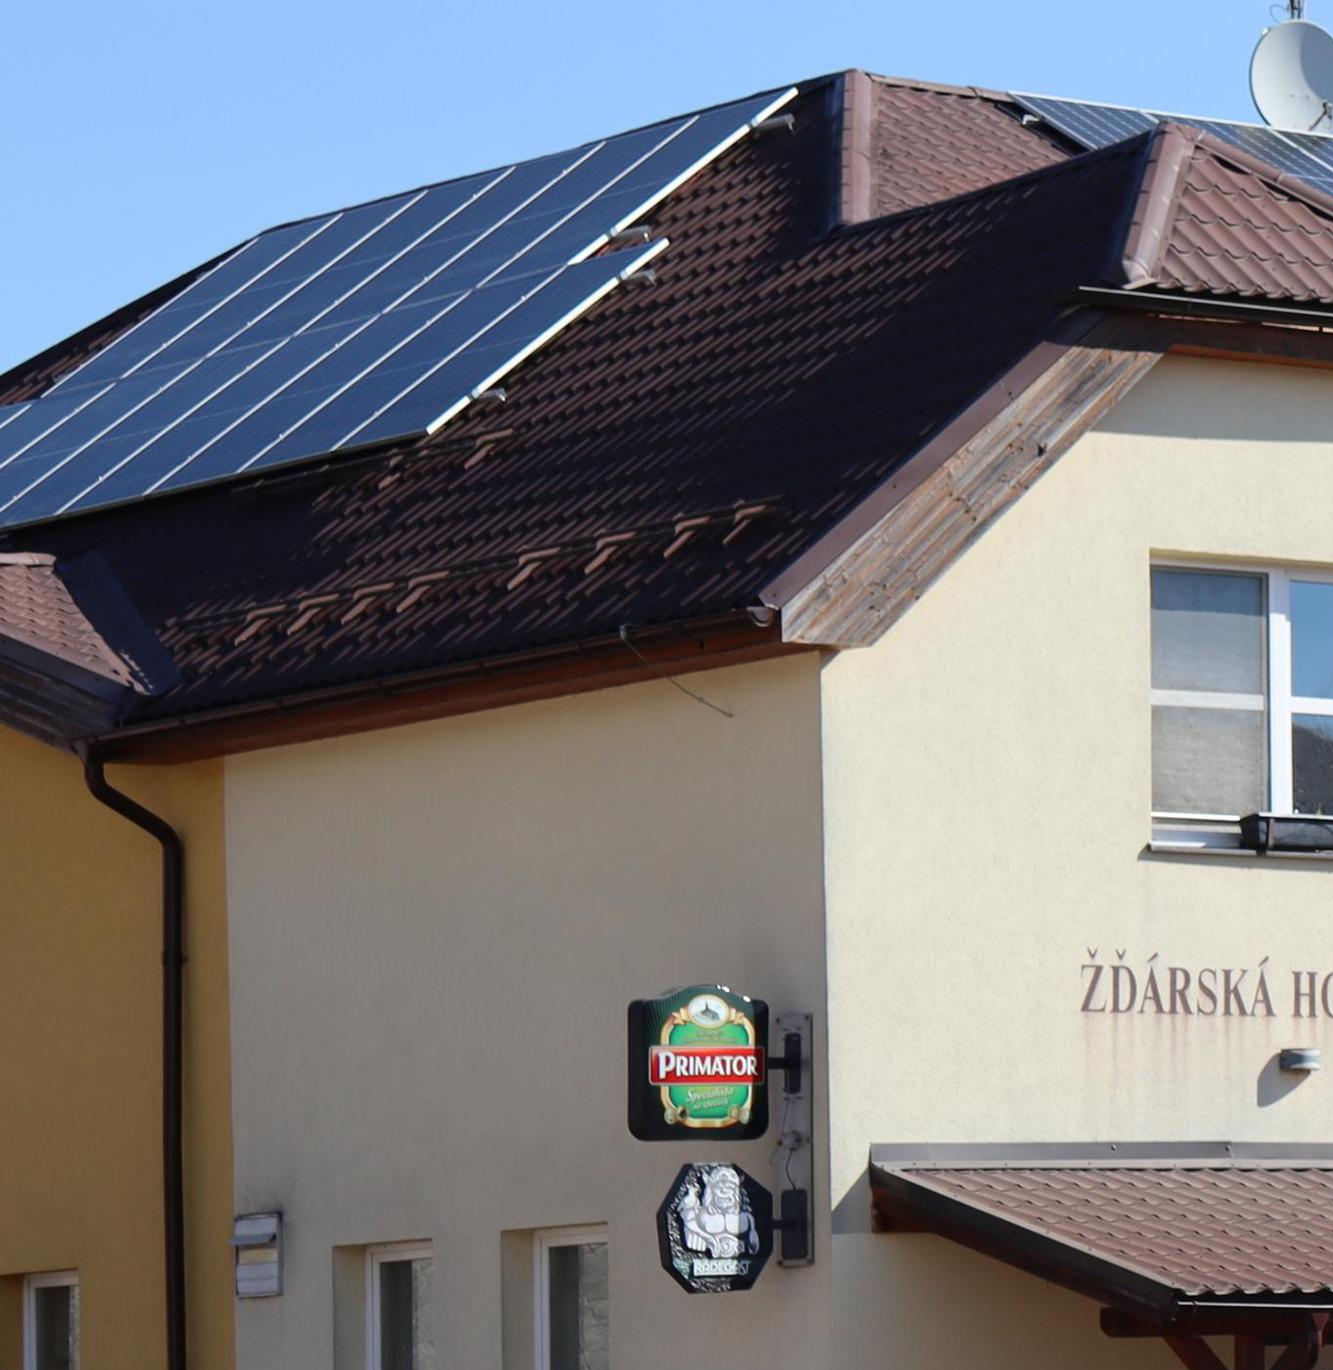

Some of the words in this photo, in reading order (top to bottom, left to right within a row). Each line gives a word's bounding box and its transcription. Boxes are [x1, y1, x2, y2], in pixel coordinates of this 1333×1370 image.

[1080, 947, 1277, 1018] ŽĎÁRSKÁ
[657, 1050, 759, 1080] PRIMATOR
[693, 1258, 750, 1276] RADEGAST
